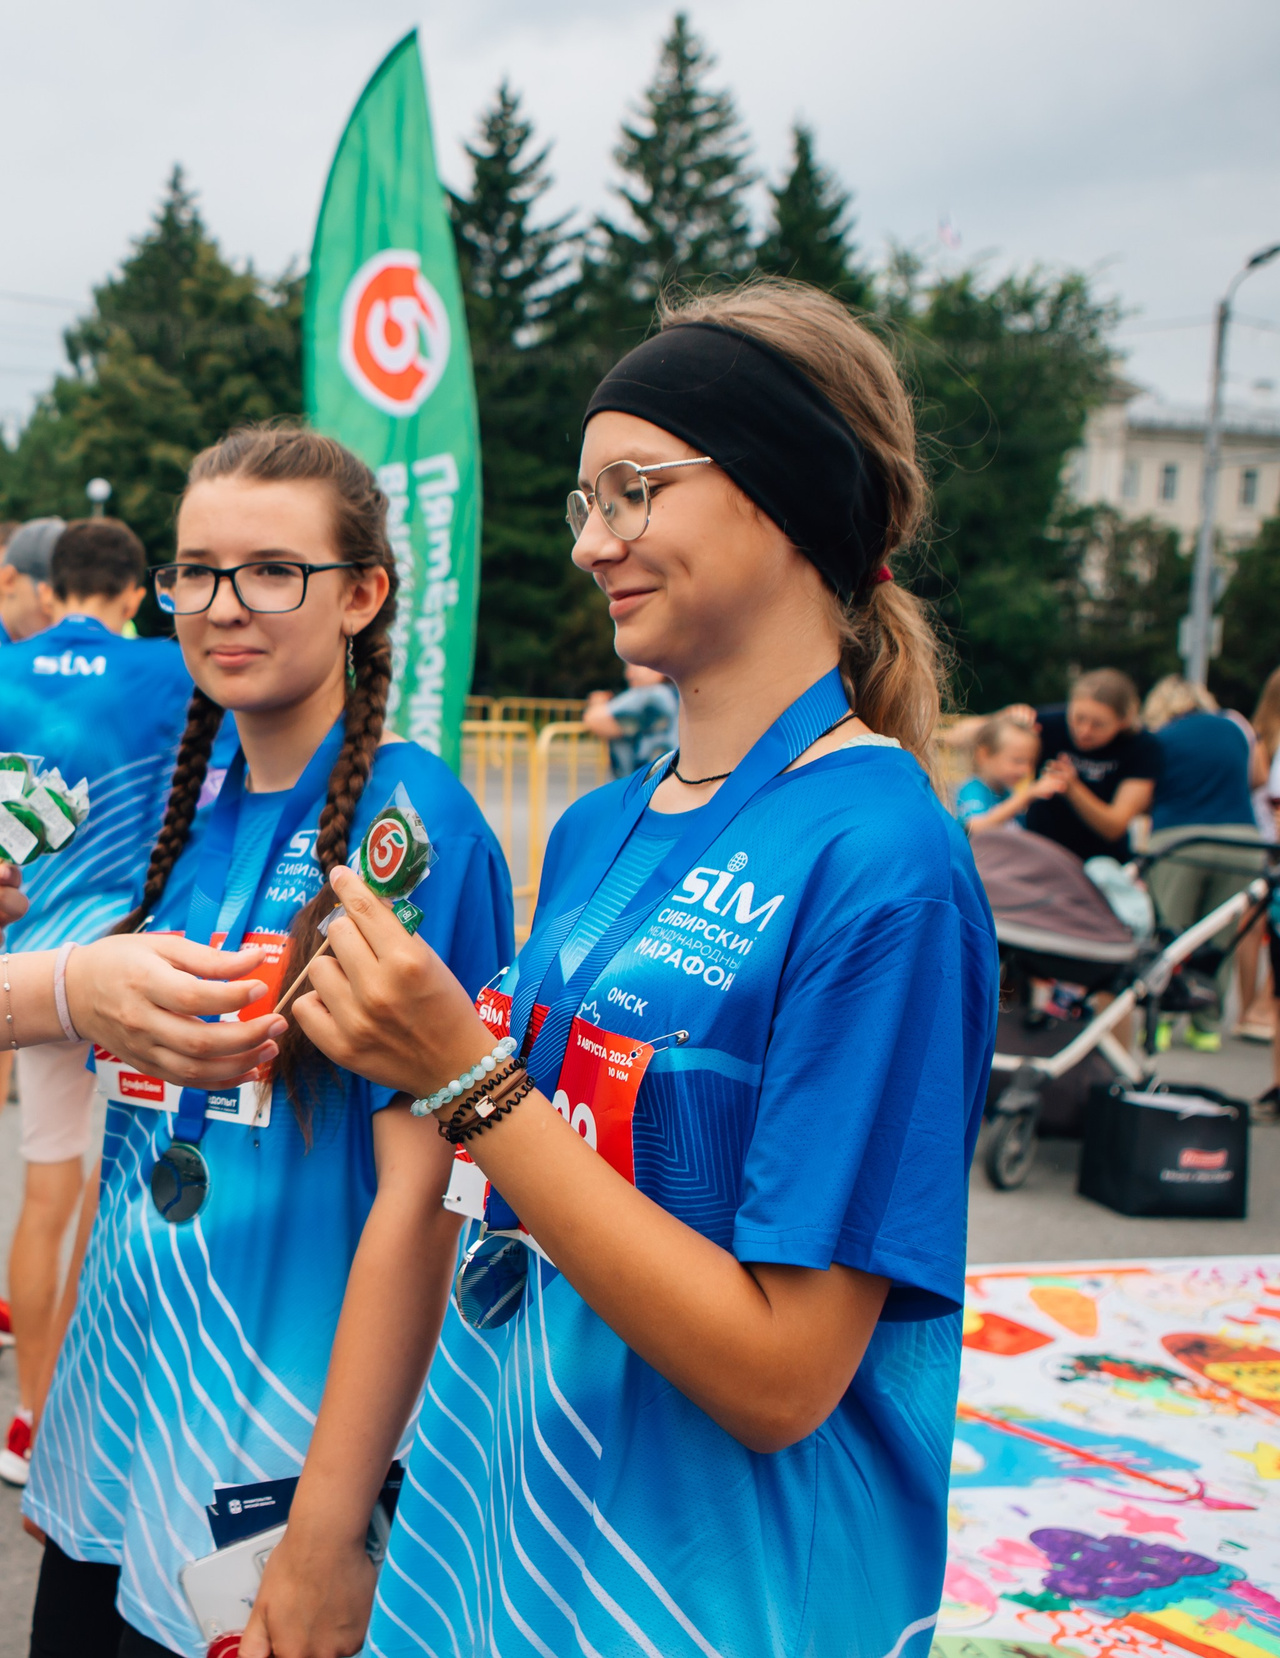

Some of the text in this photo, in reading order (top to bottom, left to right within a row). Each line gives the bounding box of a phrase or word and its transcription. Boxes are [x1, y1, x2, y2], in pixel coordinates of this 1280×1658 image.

[265, 886, 314, 908] МАРА
[634, 936, 736, 992] МАРАФОН
[607, 986, 649, 1018] ОМСК
[576, 1035, 633, 1068] 3 АВГУСТА 2024
[607, 1066, 614, 1078] 10
